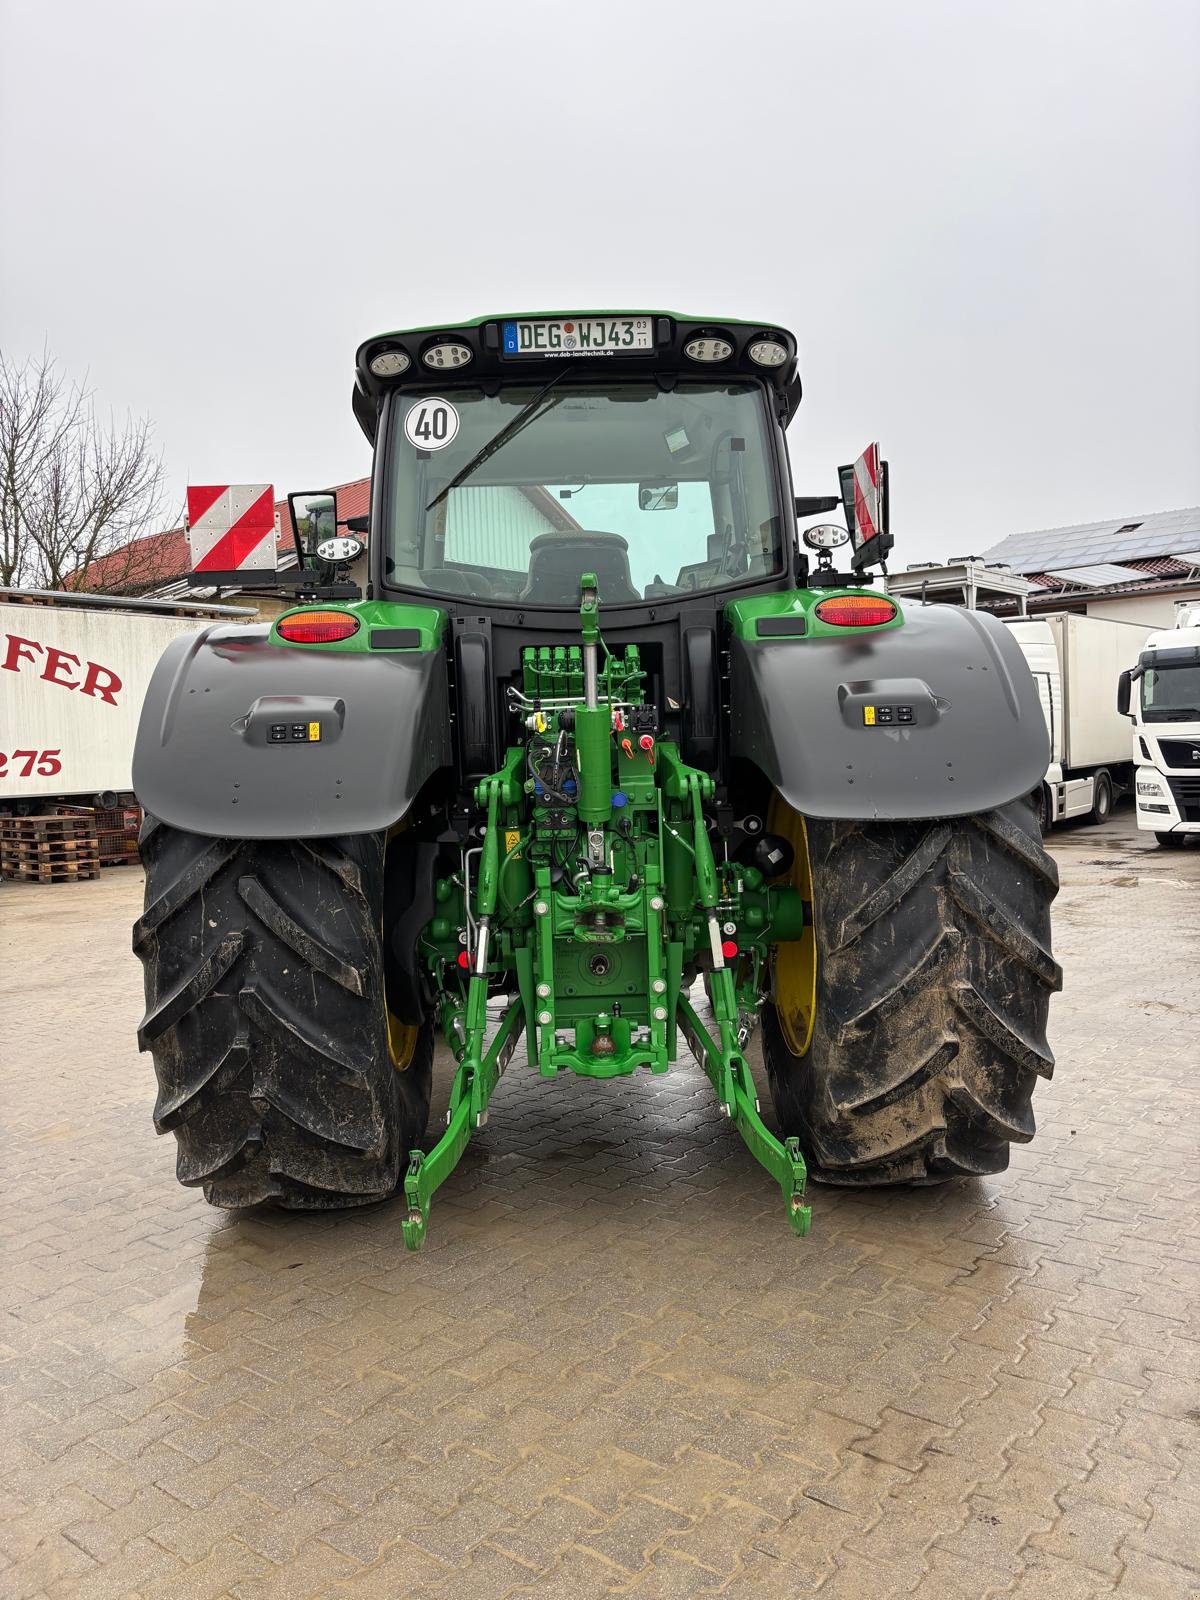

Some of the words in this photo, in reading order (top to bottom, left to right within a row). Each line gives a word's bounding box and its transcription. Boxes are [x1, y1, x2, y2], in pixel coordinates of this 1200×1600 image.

[636, 321, 647, 329] 03
[519, 323, 562, 349] DEG
[578, 321, 634, 348] WJ43
[638, 338, 647, 346] 11
[508, 340, 515, 349] D
[415, 408, 447, 440] 40
[1, 633, 123, 706] FER
